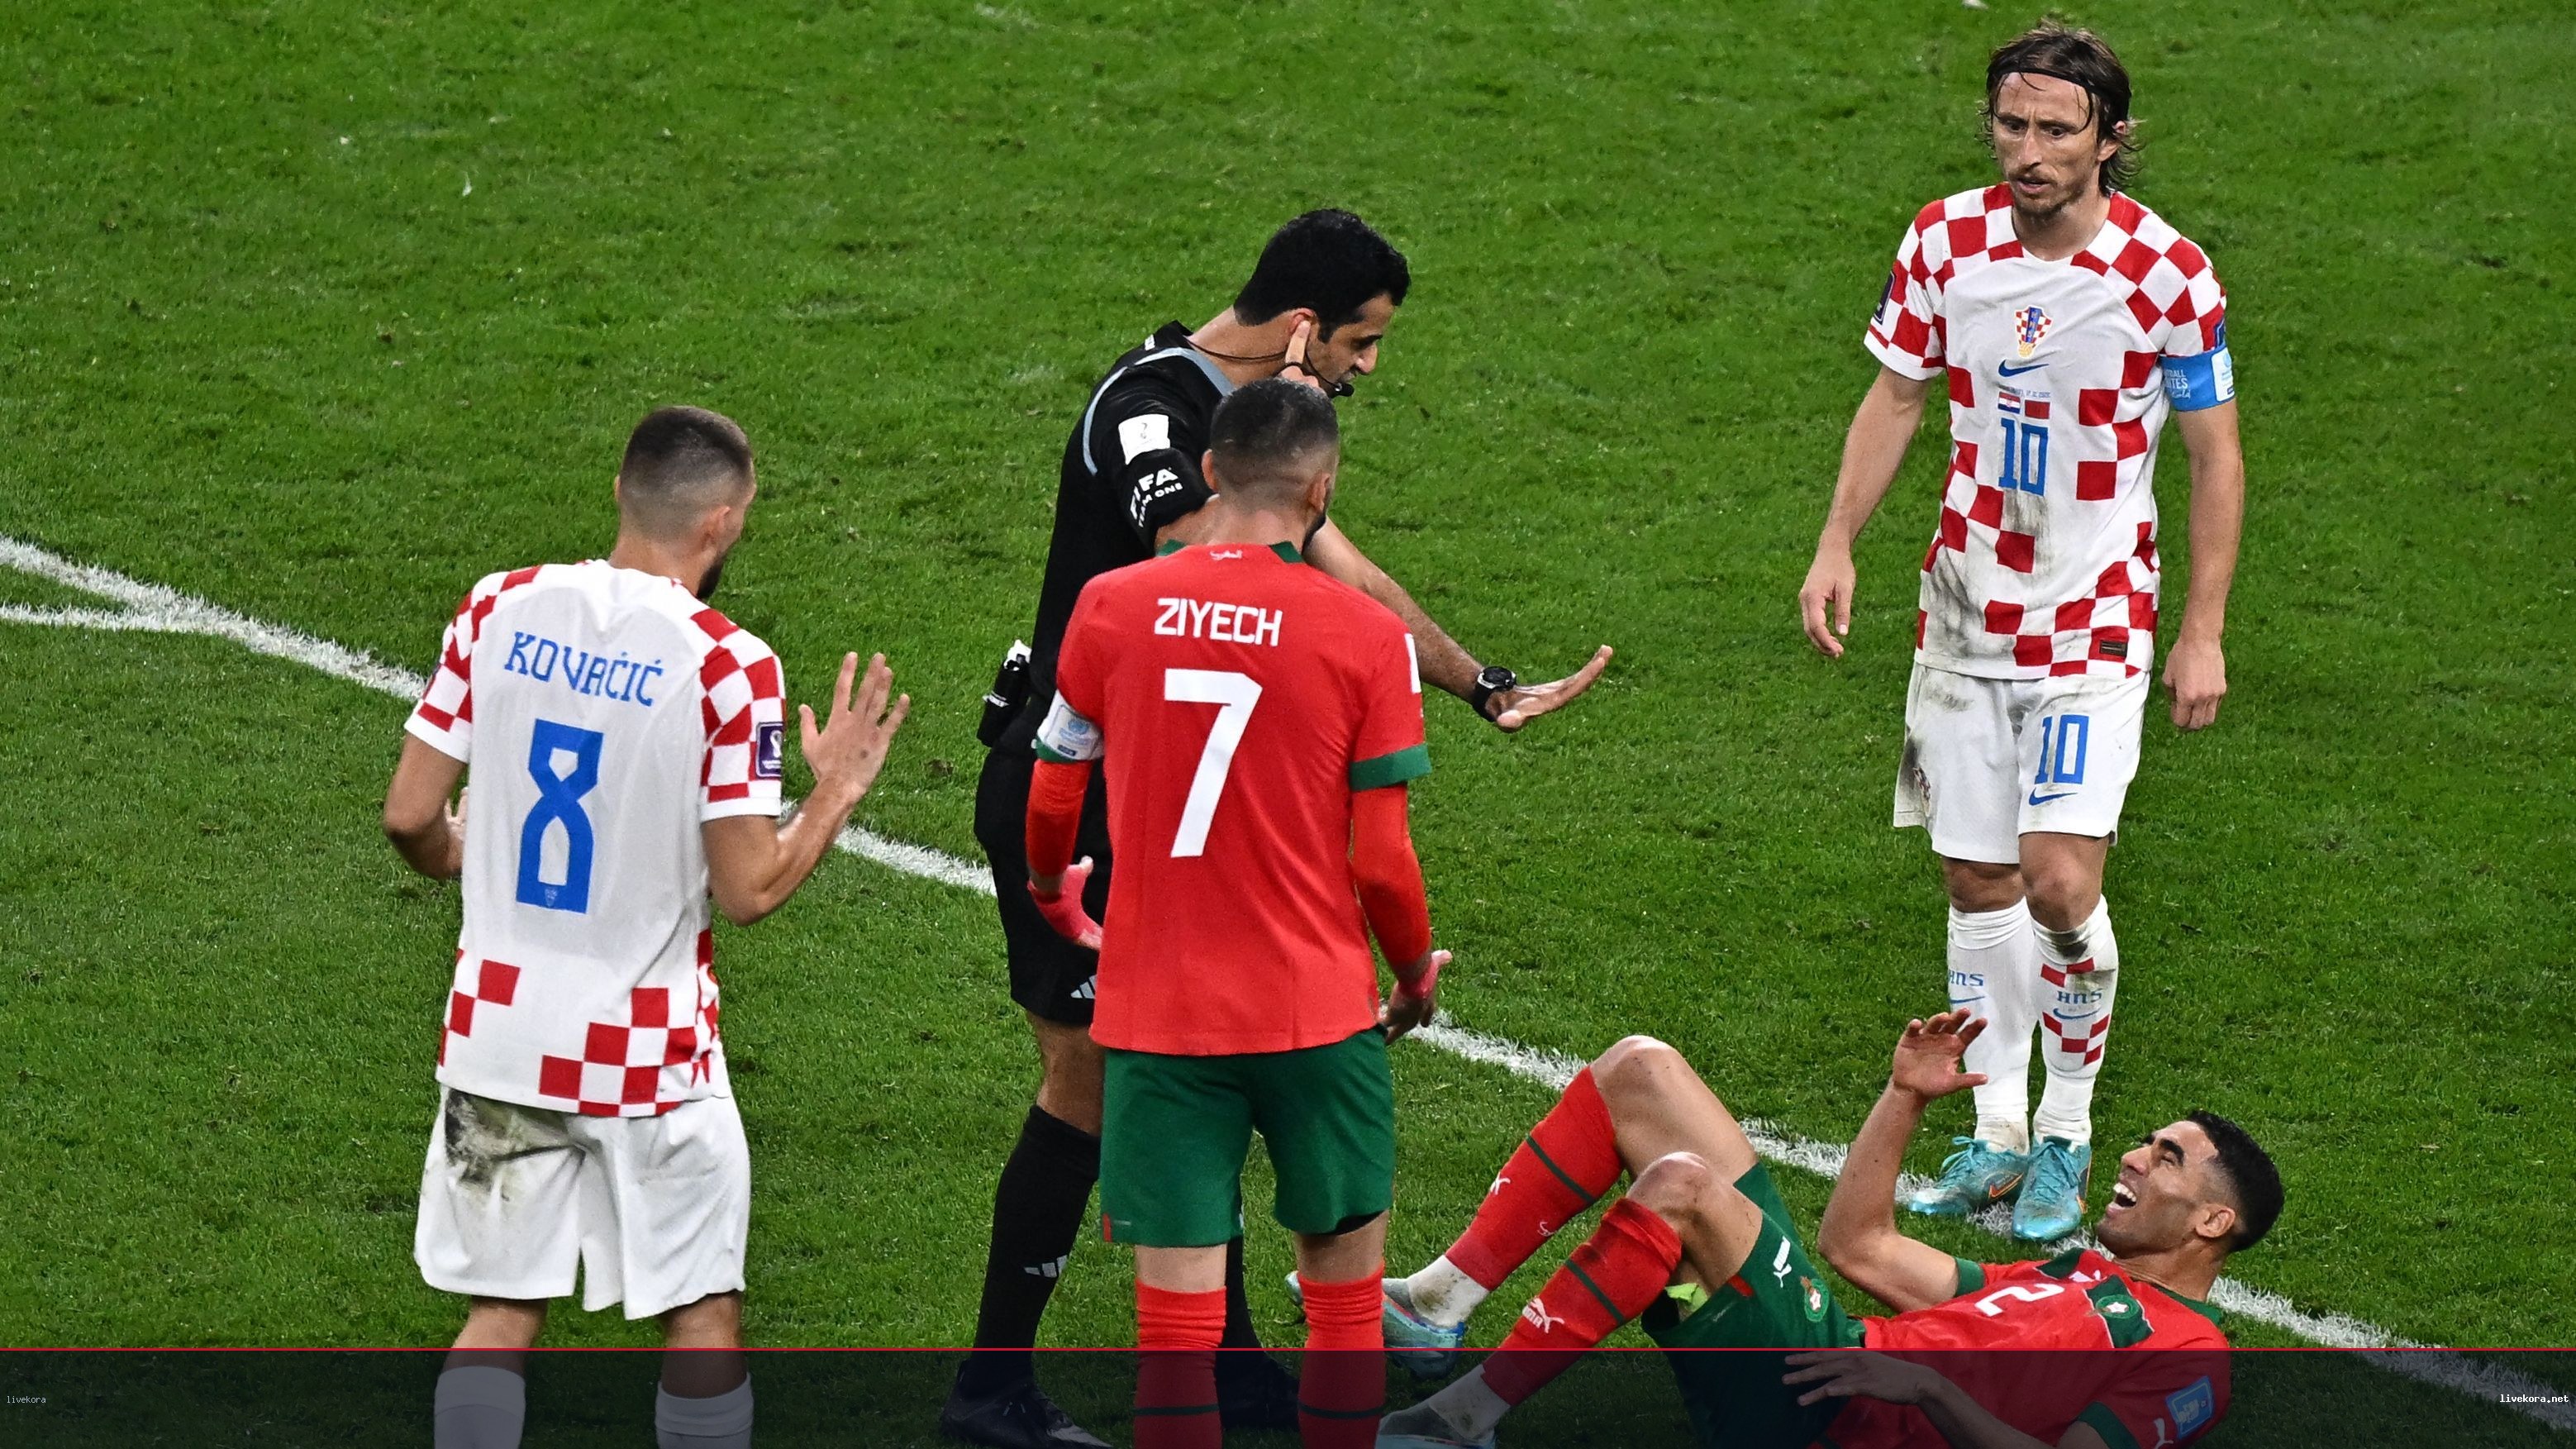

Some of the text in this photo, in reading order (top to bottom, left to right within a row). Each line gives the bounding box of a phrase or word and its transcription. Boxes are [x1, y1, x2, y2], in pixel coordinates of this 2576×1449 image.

[1998, 417, 2049, 496] 10
[1130, 469, 1178, 520] FIFA
[1155, 483, 1183, 498] ONE
[1155, 598, 1283, 646] ZIYECH
[1164, 669, 1263, 858] 7
[2034, 714, 2089, 784] 10
[516, 718, 603, 914] 8
[1974, 1283, 2064, 1317] 2
